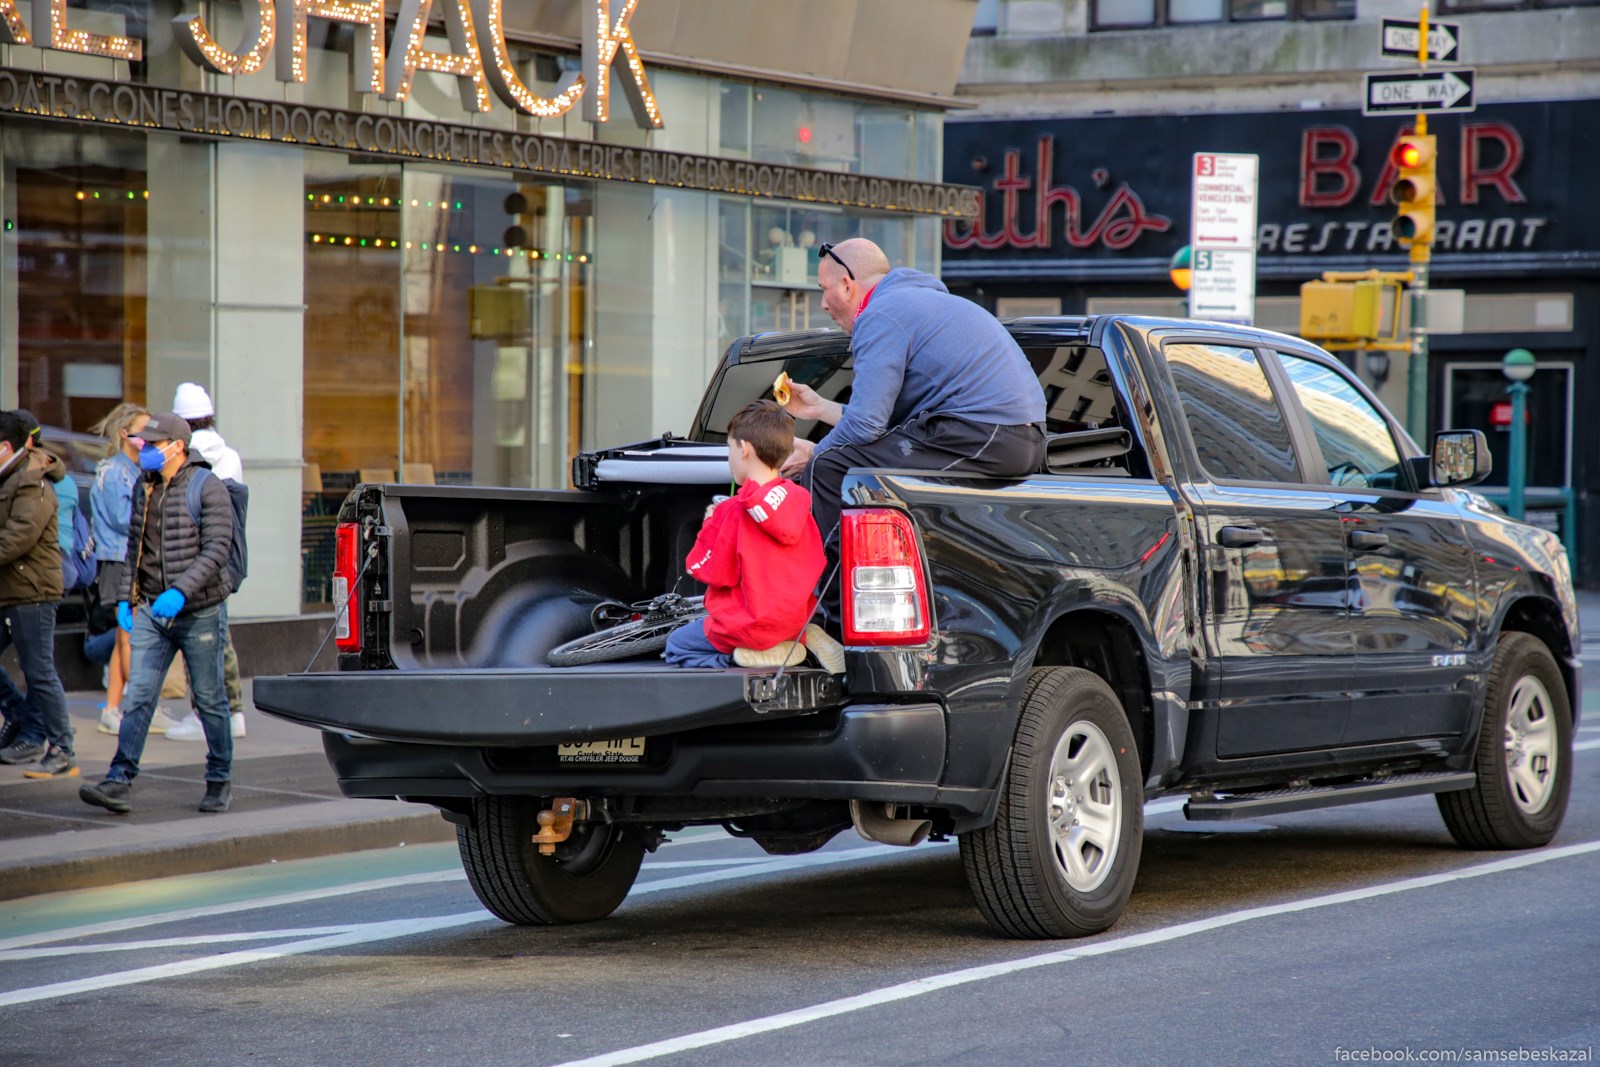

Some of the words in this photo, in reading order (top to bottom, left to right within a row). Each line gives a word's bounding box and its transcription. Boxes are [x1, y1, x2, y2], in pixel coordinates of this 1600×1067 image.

[1392, 30, 1415, 49] ONE
[1381, 84, 1412, 100] ONE
[1427, 83, 1458, 98] WAY
[89, 83, 195, 130] CONES
[204, 96, 265, 137] HOT
[271, 104, 347, 147] DOGS
[355, 115, 504, 164] CONCRETES
[511, 135, 572, 171] SODA
[579, 143, 634, 178] FRIES
[640, 152, 729, 191] BURGERS
[735, 162, 809, 198] FROZEN
[812, 172, 892, 207] CUSTARD
[895, 182, 933, 210] HOT
[936, 188, 980, 216] DOGS
[1200, 156, 1213, 175] 3
[1199, 183, 1244, 192] COMMERCIAL
[1199, 194, 1232, 203] VEHICLES
[1234, 195, 1253, 204] ONLY
[1257, 217, 1546, 251] RESTARANT
[1197, 251, 1209, 269] 5
[1431, 654, 1466, 667] RAM
